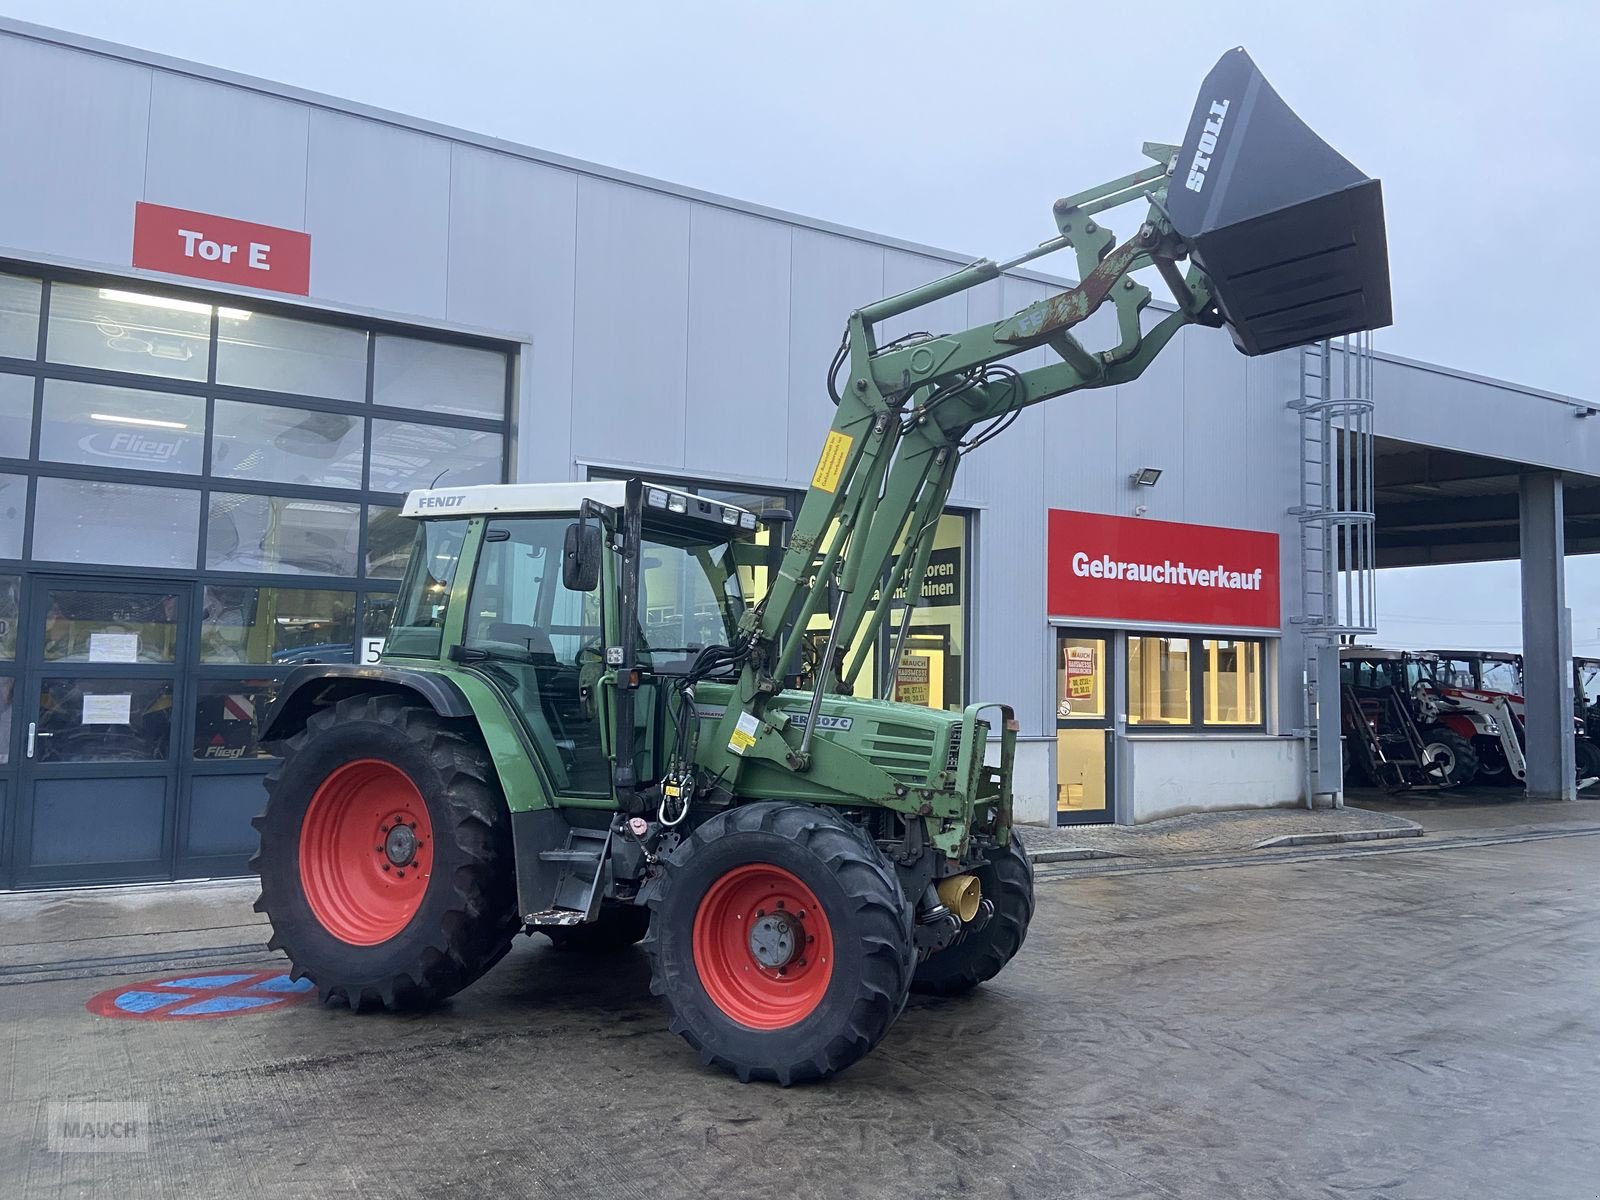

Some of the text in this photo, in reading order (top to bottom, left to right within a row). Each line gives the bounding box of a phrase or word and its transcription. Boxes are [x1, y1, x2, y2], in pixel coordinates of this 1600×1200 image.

[1185, 99, 1230, 193] STOLL
[177, 229, 271, 271] Tor E
[109, 432, 183, 459] Fliegl
[418, 495, 467, 508] FENDT
[1072, 551, 1262, 591] Gebrauchtverkauf
[367, 641, 381, 663] 5
[204, 745, 247, 759] Fliegl
